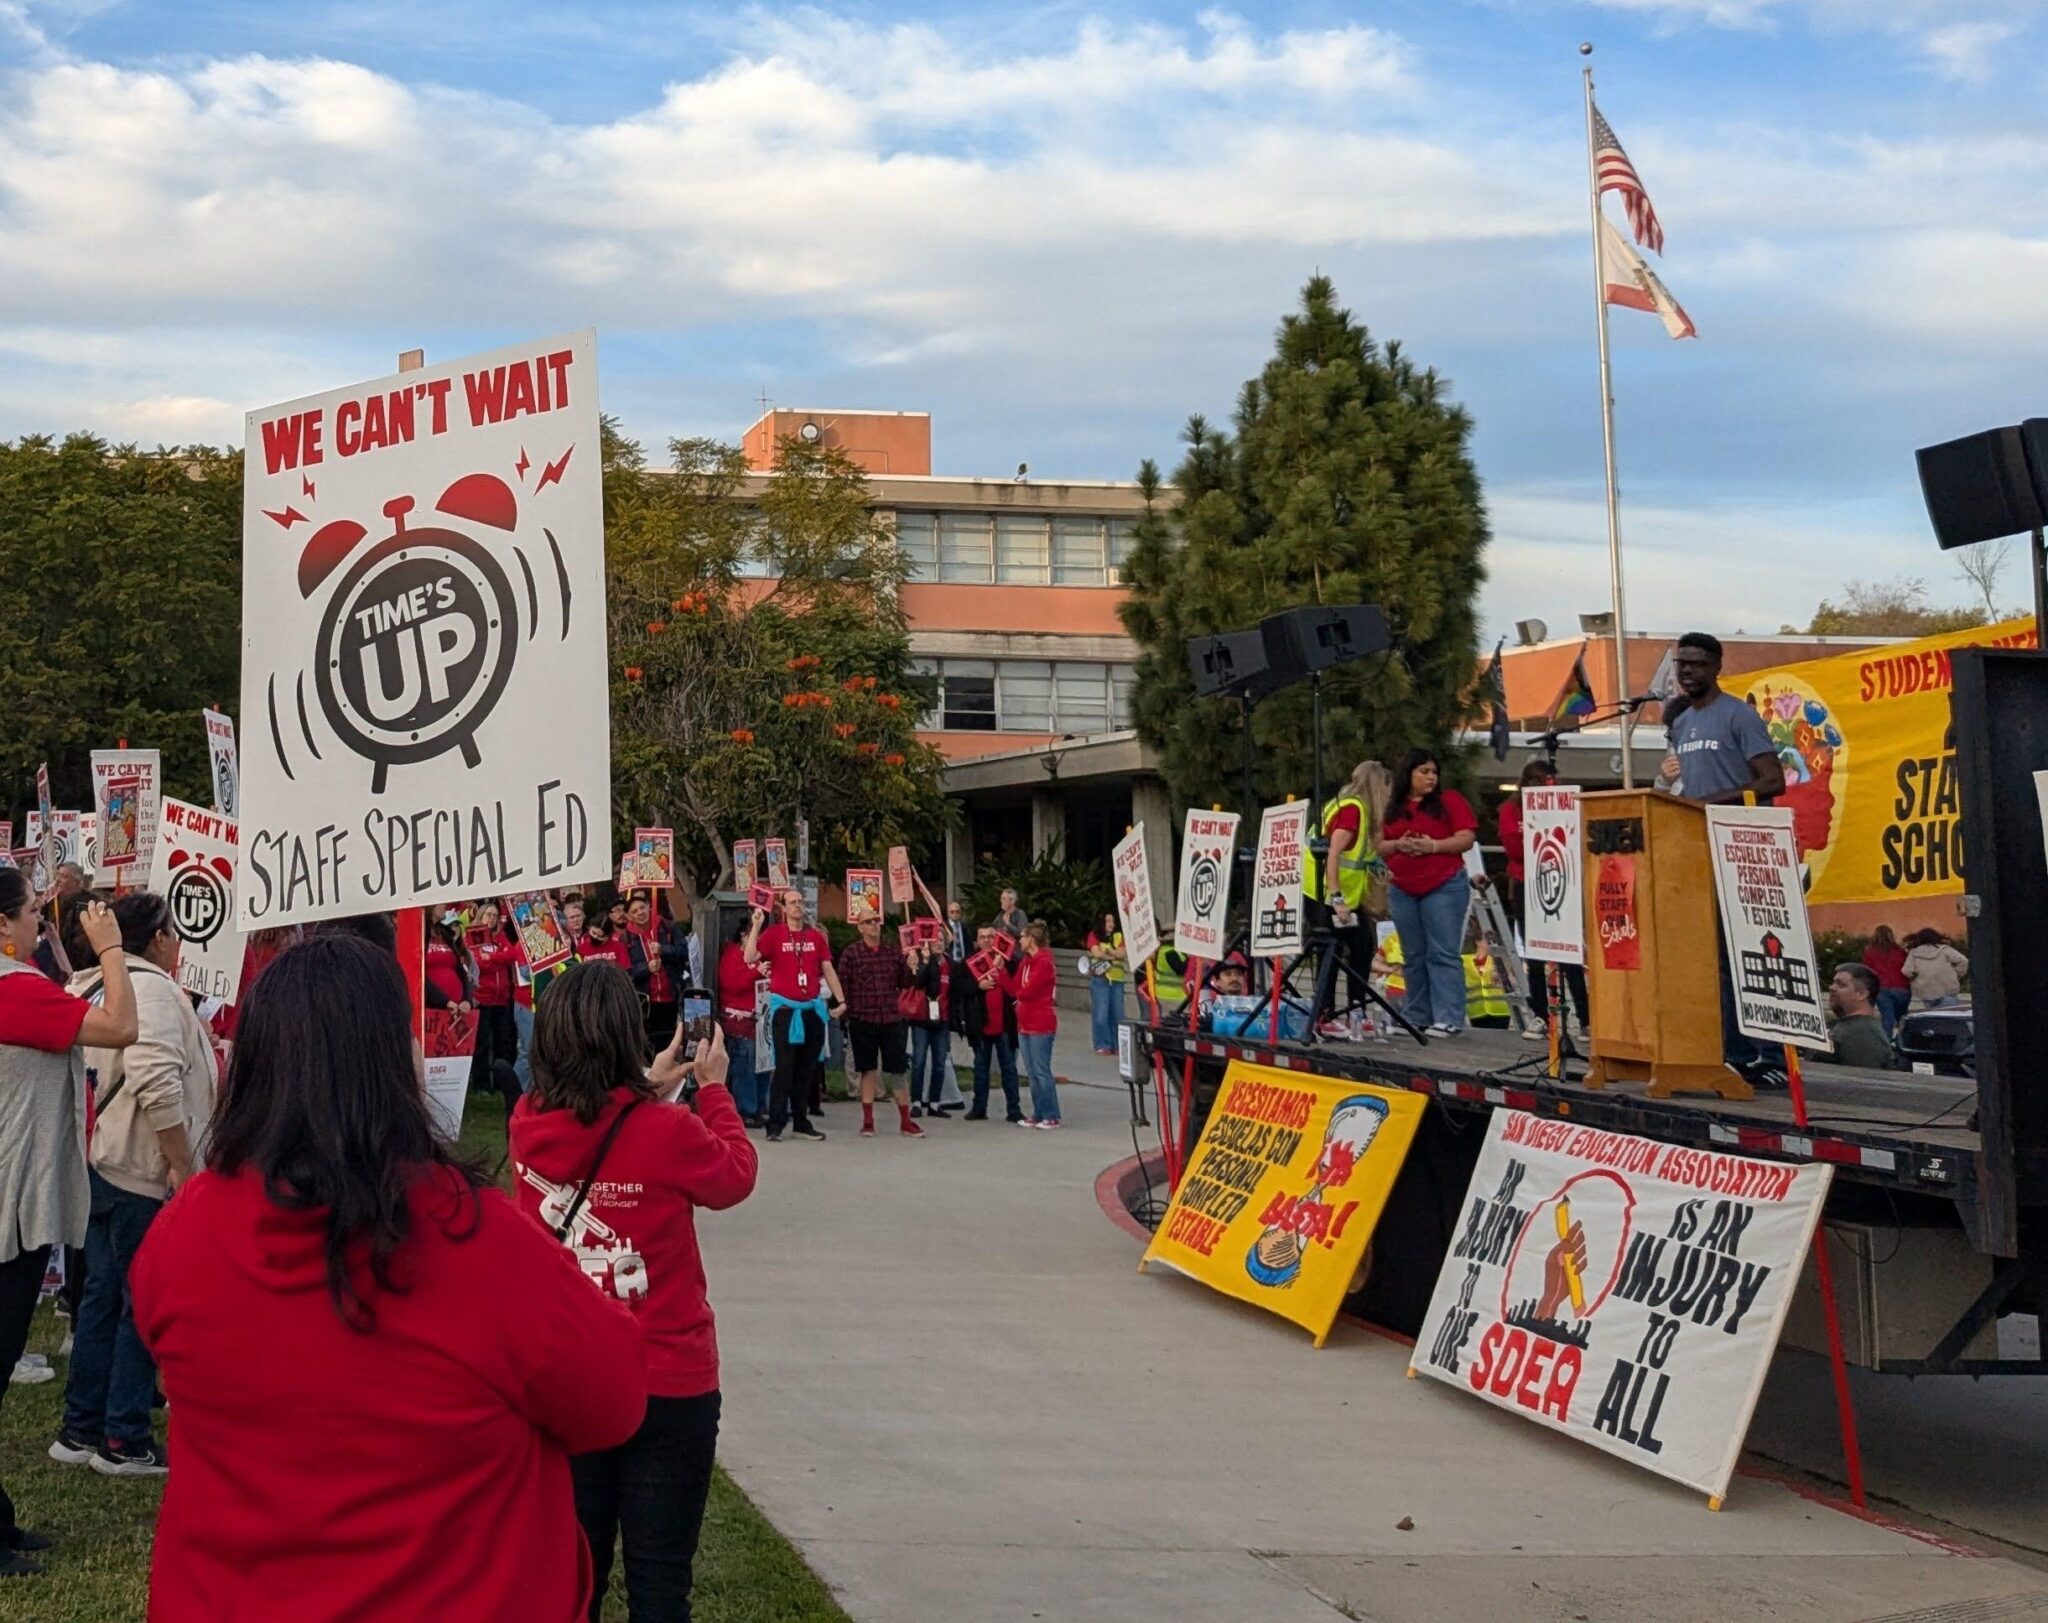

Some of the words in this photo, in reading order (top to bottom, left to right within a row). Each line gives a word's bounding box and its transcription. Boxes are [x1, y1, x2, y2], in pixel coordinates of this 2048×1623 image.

[261, 408, 323, 476] WE
[335, 378, 452, 458] CAN'T
[463, 350, 573, 427] WAIT
[355, 575, 457, 640] TIME'S
[360, 611, 477, 722] UP
[1861, 648, 1952, 702] STUDEN
[1705, 740, 1718, 750] FC
[96, 765, 115, 776] WE
[118, 764, 153, 776] CAN'T
[140, 778, 153, 790] IT
[1895, 755, 1959, 821] STA
[140, 823, 156, 832] ure
[141, 810, 154, 819] the
[166, 802, 185, 827] WE
[186, 810, 222, 839] CAN'T
[248, 823, 349, 918] STAFF
[362, 800, 524, 897] SPECIAL
[538, 779, 588, 876] ED
[1271, 830, 1296, 844] FULLY
[1732, 829, 1776, 846] NECESITAMOS
[1882, 817, 1966, 890] SCHO
[1725, 844, 1769, 866] ESCUELAS
[1771, 847, 1790, 868] CON
[181, 884, 212, 897] TIME'S
[1260, 872, 1300, 888] SCHOOLS
[1540, 870, 1560, 900] UP
[1600, 881, 1628, 895] FULLY
[1737, 864, 1783, 887] PERSONAL
[1197, 882, 1213, 904] UP
[1737, 885, 1786, 908] COMPLETO
[179, 897, 214, 928] UP
[1743, 906, 1750, 925] Y
[1753, 907, 1791, 930] ESTABLE
[213, 970, 230, 999] ED
[1755, 1005, 1789, 1029] PODEMOS
[1790, 1010, 1824, 1036] ESPERAR
[1223, 1079, 1317, 1130] NECESITAMOS
[1204, 1114, 1272, 1158] ESCUELAS
[1265, 1127, 1303, 1167] CON
[1502, 1112, 1529, 1143] SAN
[1524, 1119, 1574, 1152] DIEGO
[1566, 1129, 1664, 1175] EDUCATION
[1657, 1147, 1798, 1202] ASSOCIATION
[1196, 1147, 1269, 1194] PERSONAL
[594, 1200, 638, 1208] STRONGER
[601, 1191, 618, 1200] ARE
[1178, 1175, 1249, 1225] COMPLETO
[1453, 1197, 1531, 1267] INJURY
[1667, 1199, 1708, 1242] IS
[1697, 1200, 1753, 1256] AN
[1457, 1263, 1481, 1310] TO
[1612, 1231, 1771, 1335] INJURY
[1430, 1305, 1479, 1374] ONE
[1635, 1311, 1680, 1370] TO
[1469, 1321, 1582, 1423] SDEA
[1592, 1358, 1670, 1455] ALL
